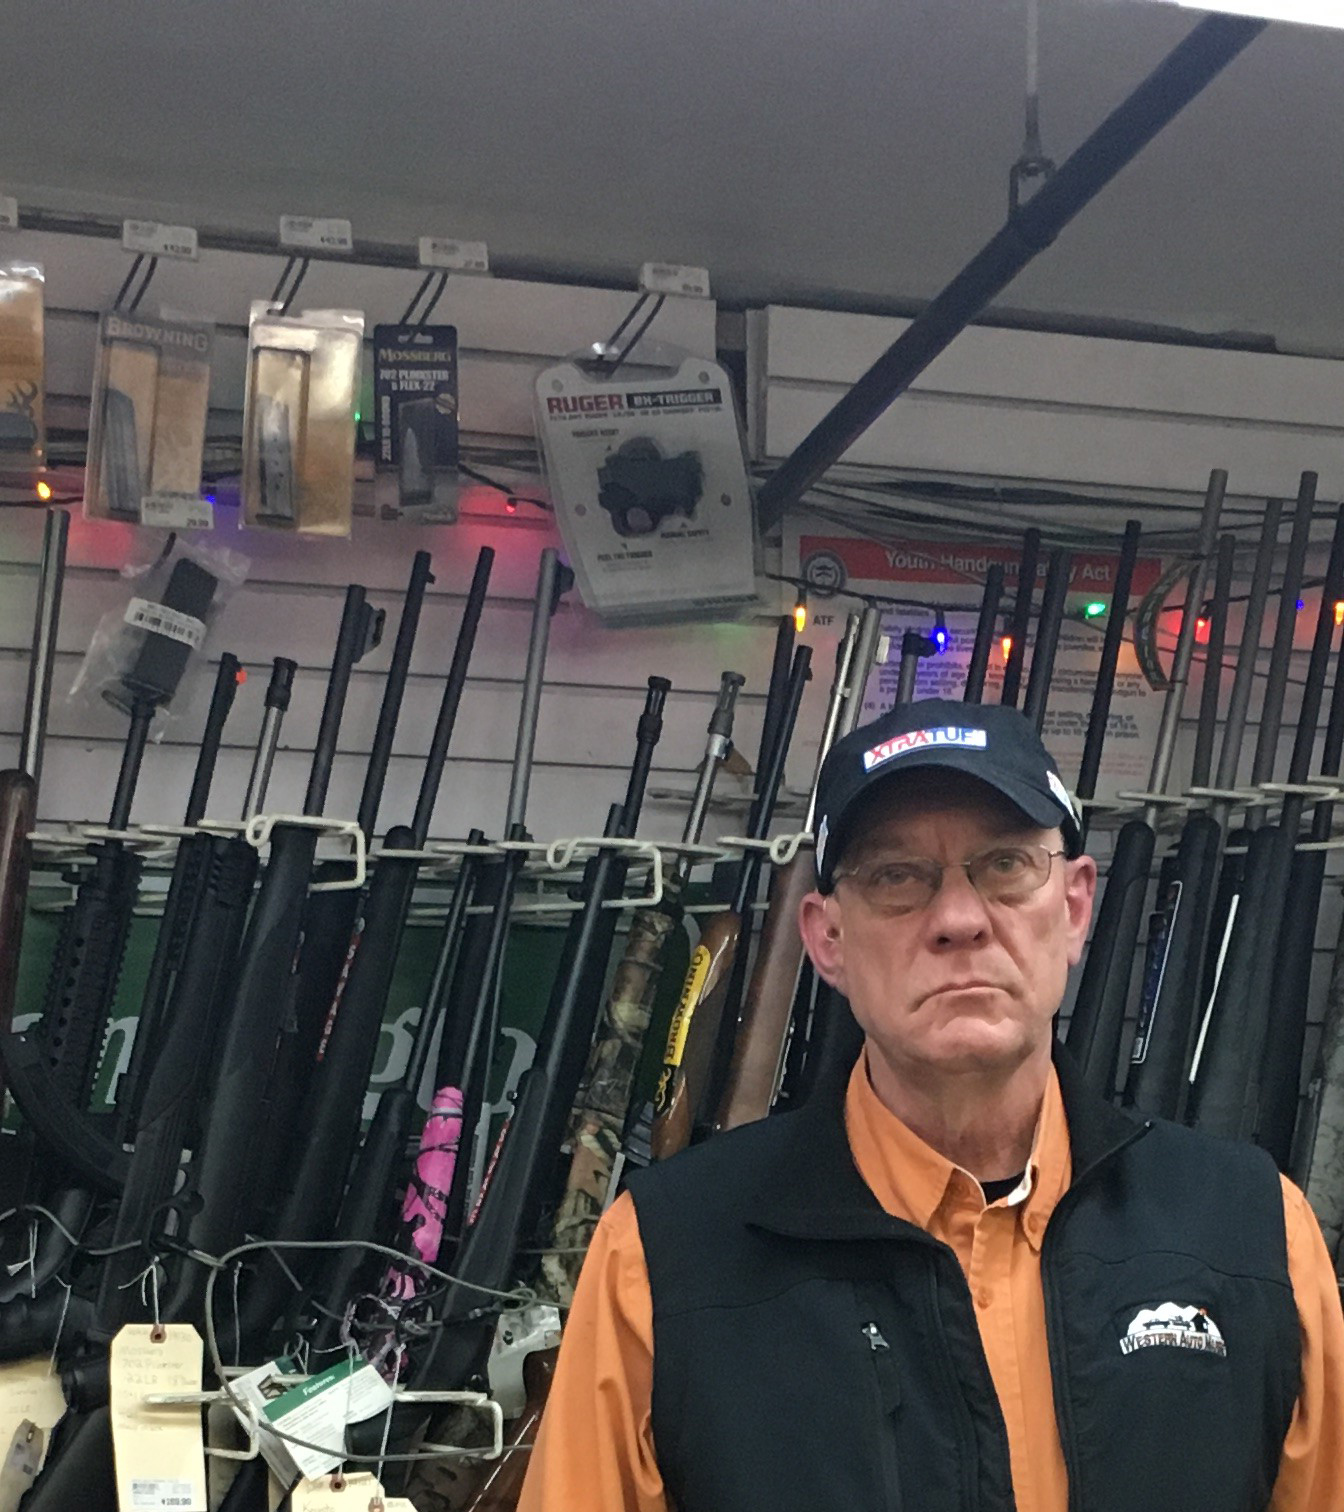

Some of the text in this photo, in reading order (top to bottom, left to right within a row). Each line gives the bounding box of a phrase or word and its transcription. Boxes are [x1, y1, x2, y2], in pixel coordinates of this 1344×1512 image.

[107, 318, 209, 352] BROWNING
[378, 349, 451, 362] MOSSBERG
[546, 390, 714, 414] RUGER BX-TRIGGER
[1081, 563, 1112, 582] Act
[813, 614, 834, 626] ATF
[867, 728, 977, 766] XTRATUF
[1122, 1331, 1178, 1354] WESTERN
